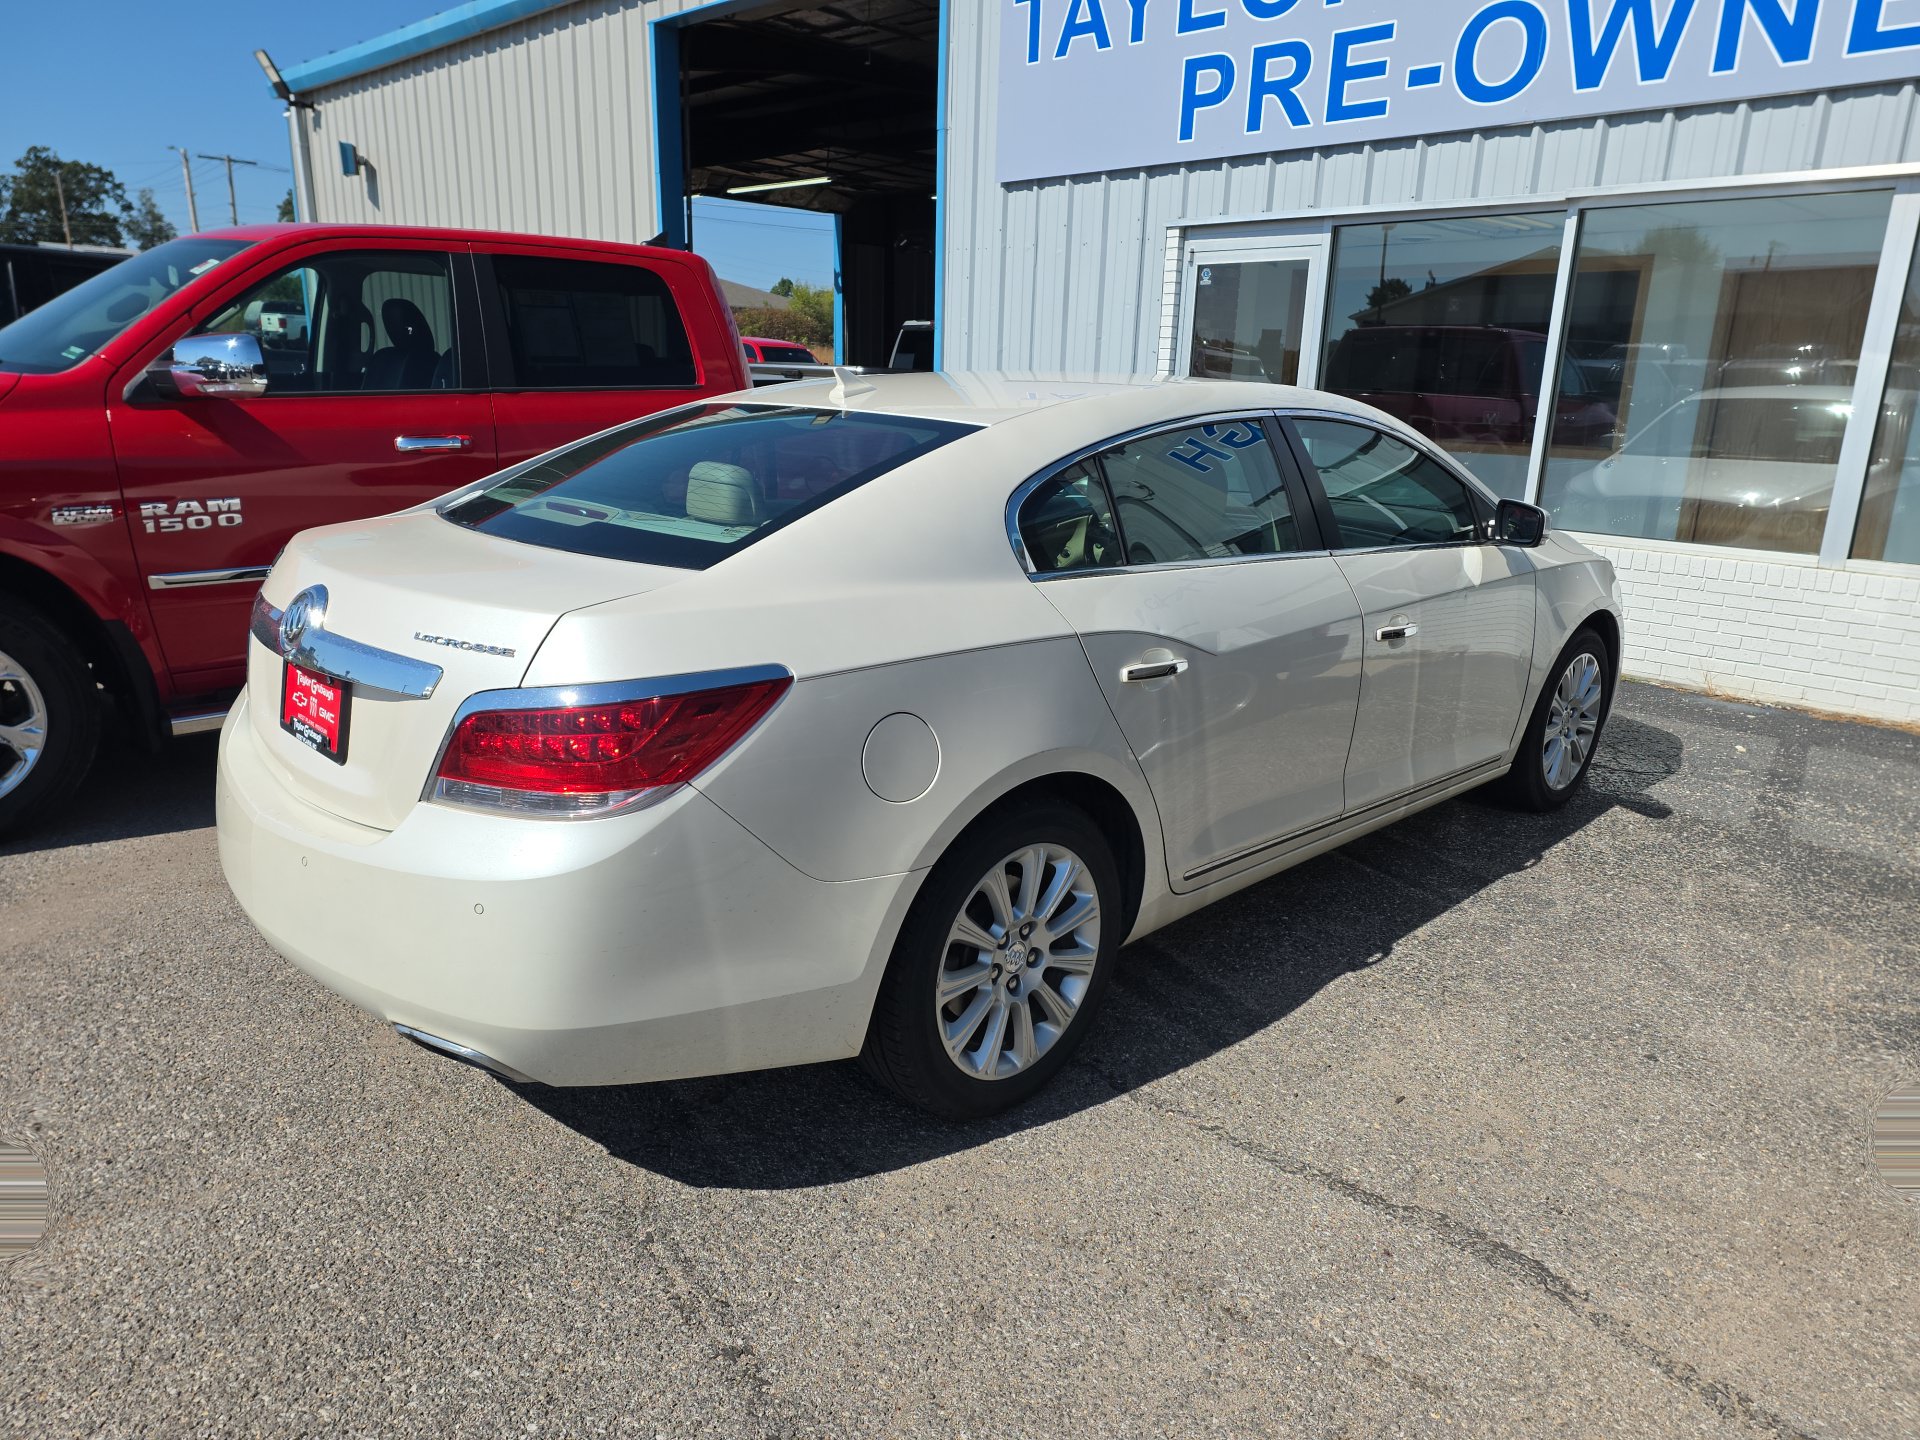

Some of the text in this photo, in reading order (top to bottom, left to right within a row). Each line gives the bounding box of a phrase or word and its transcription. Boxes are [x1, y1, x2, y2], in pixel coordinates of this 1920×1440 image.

[139, 497, 242, 518] RAM
[142, 513, 243, 533] 1500
[319, 706, 335, 724] GMC
